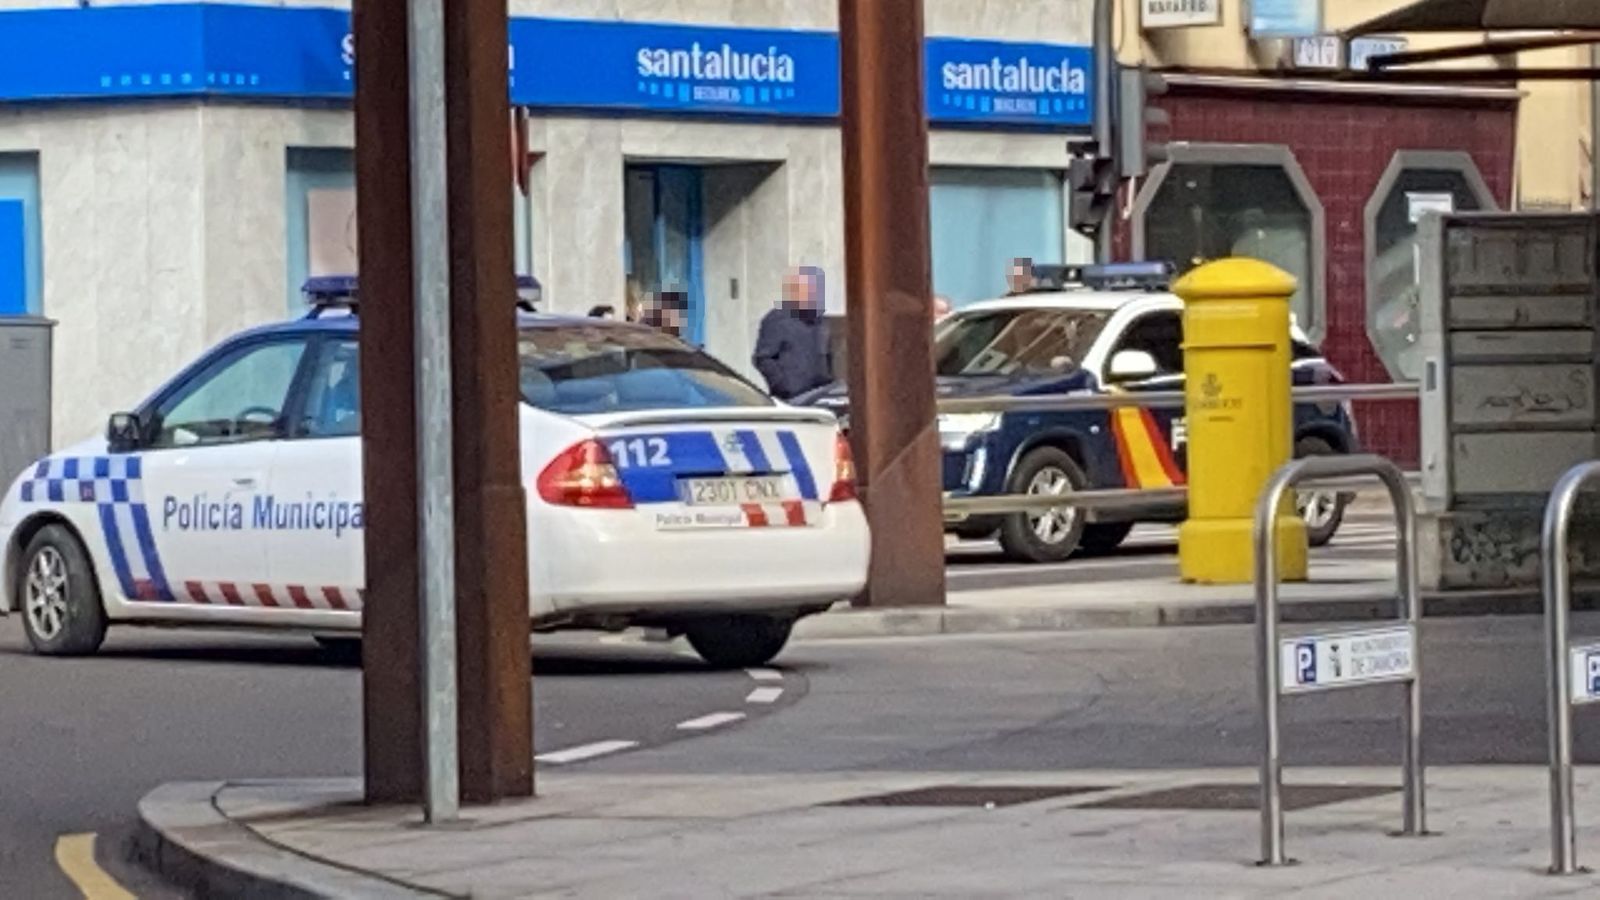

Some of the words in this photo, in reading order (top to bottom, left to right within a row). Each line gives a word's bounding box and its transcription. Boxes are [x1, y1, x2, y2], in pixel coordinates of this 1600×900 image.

[637, 41, 795, 83] santalucía
[611, 437, 672, 468] 112
[163, 492, 243, 531] Policía
[253, 491, 365, 538] Municipa
